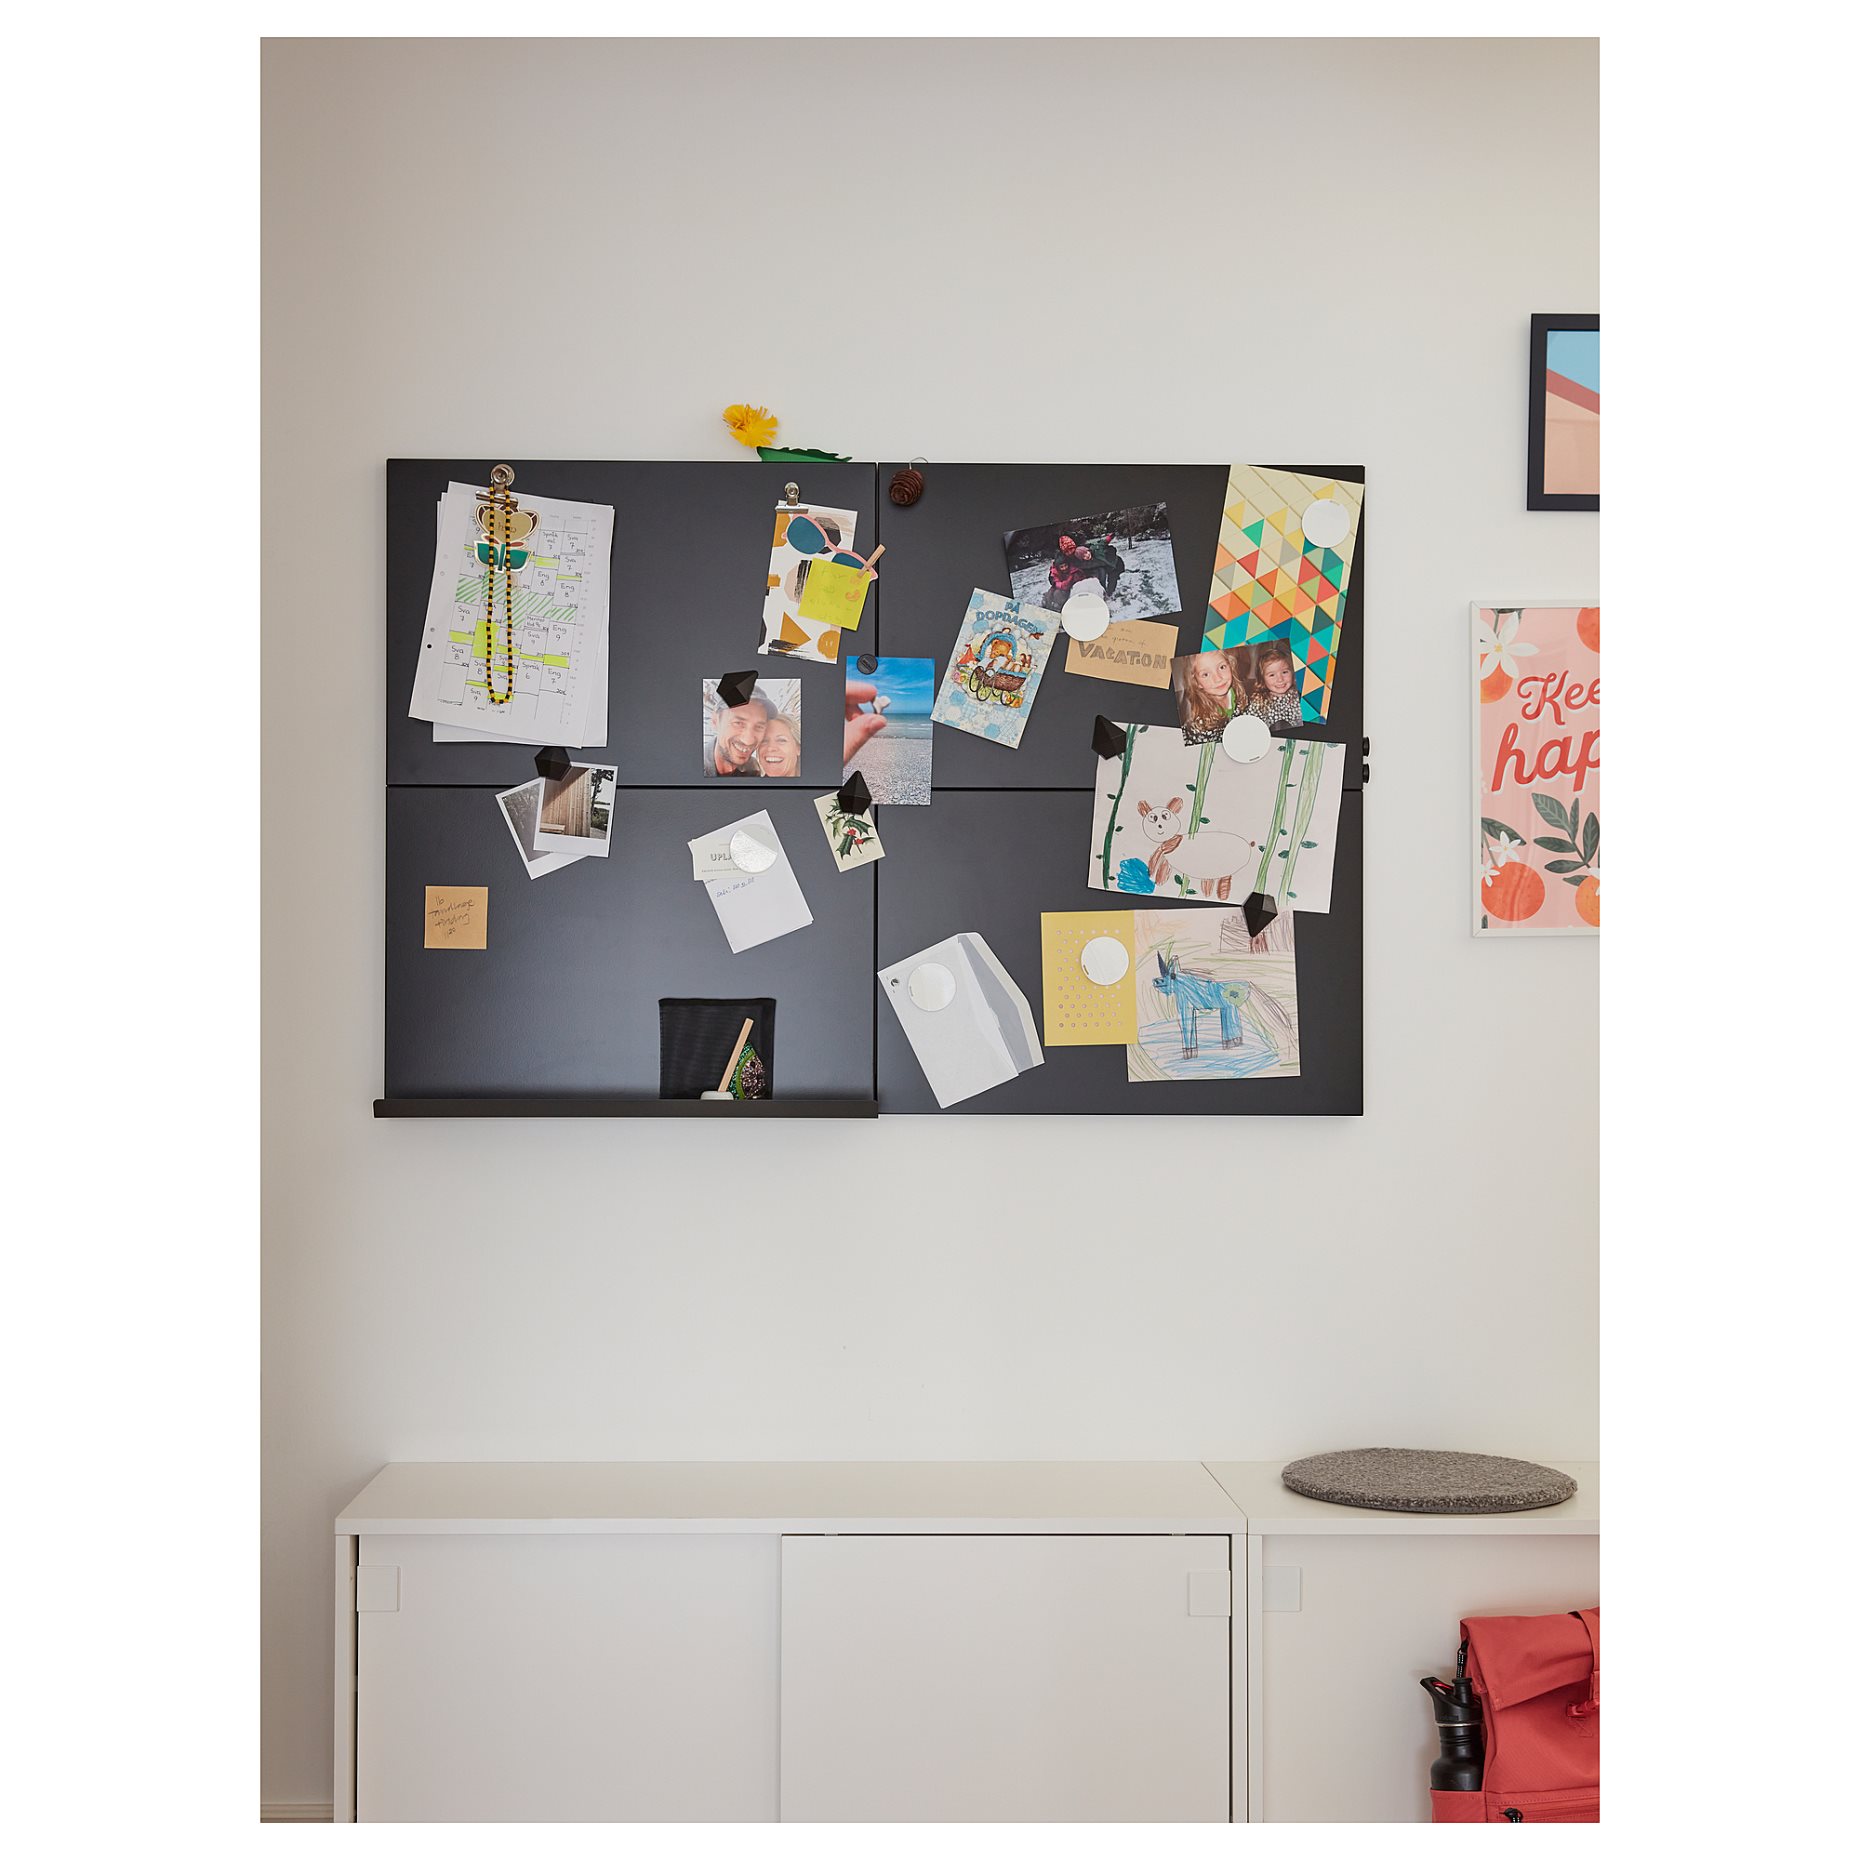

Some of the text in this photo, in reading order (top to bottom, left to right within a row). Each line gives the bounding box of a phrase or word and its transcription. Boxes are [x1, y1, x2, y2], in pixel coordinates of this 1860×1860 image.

[538, 570, 550, 580] Eng
[560, 582, 575, 593] Eng
[458, 605, 471, 615] Sva
[552, 624, 568, 634] Eng
[451, 646, 464, 654] Sva
[548, 668, 562, 680] Eng
